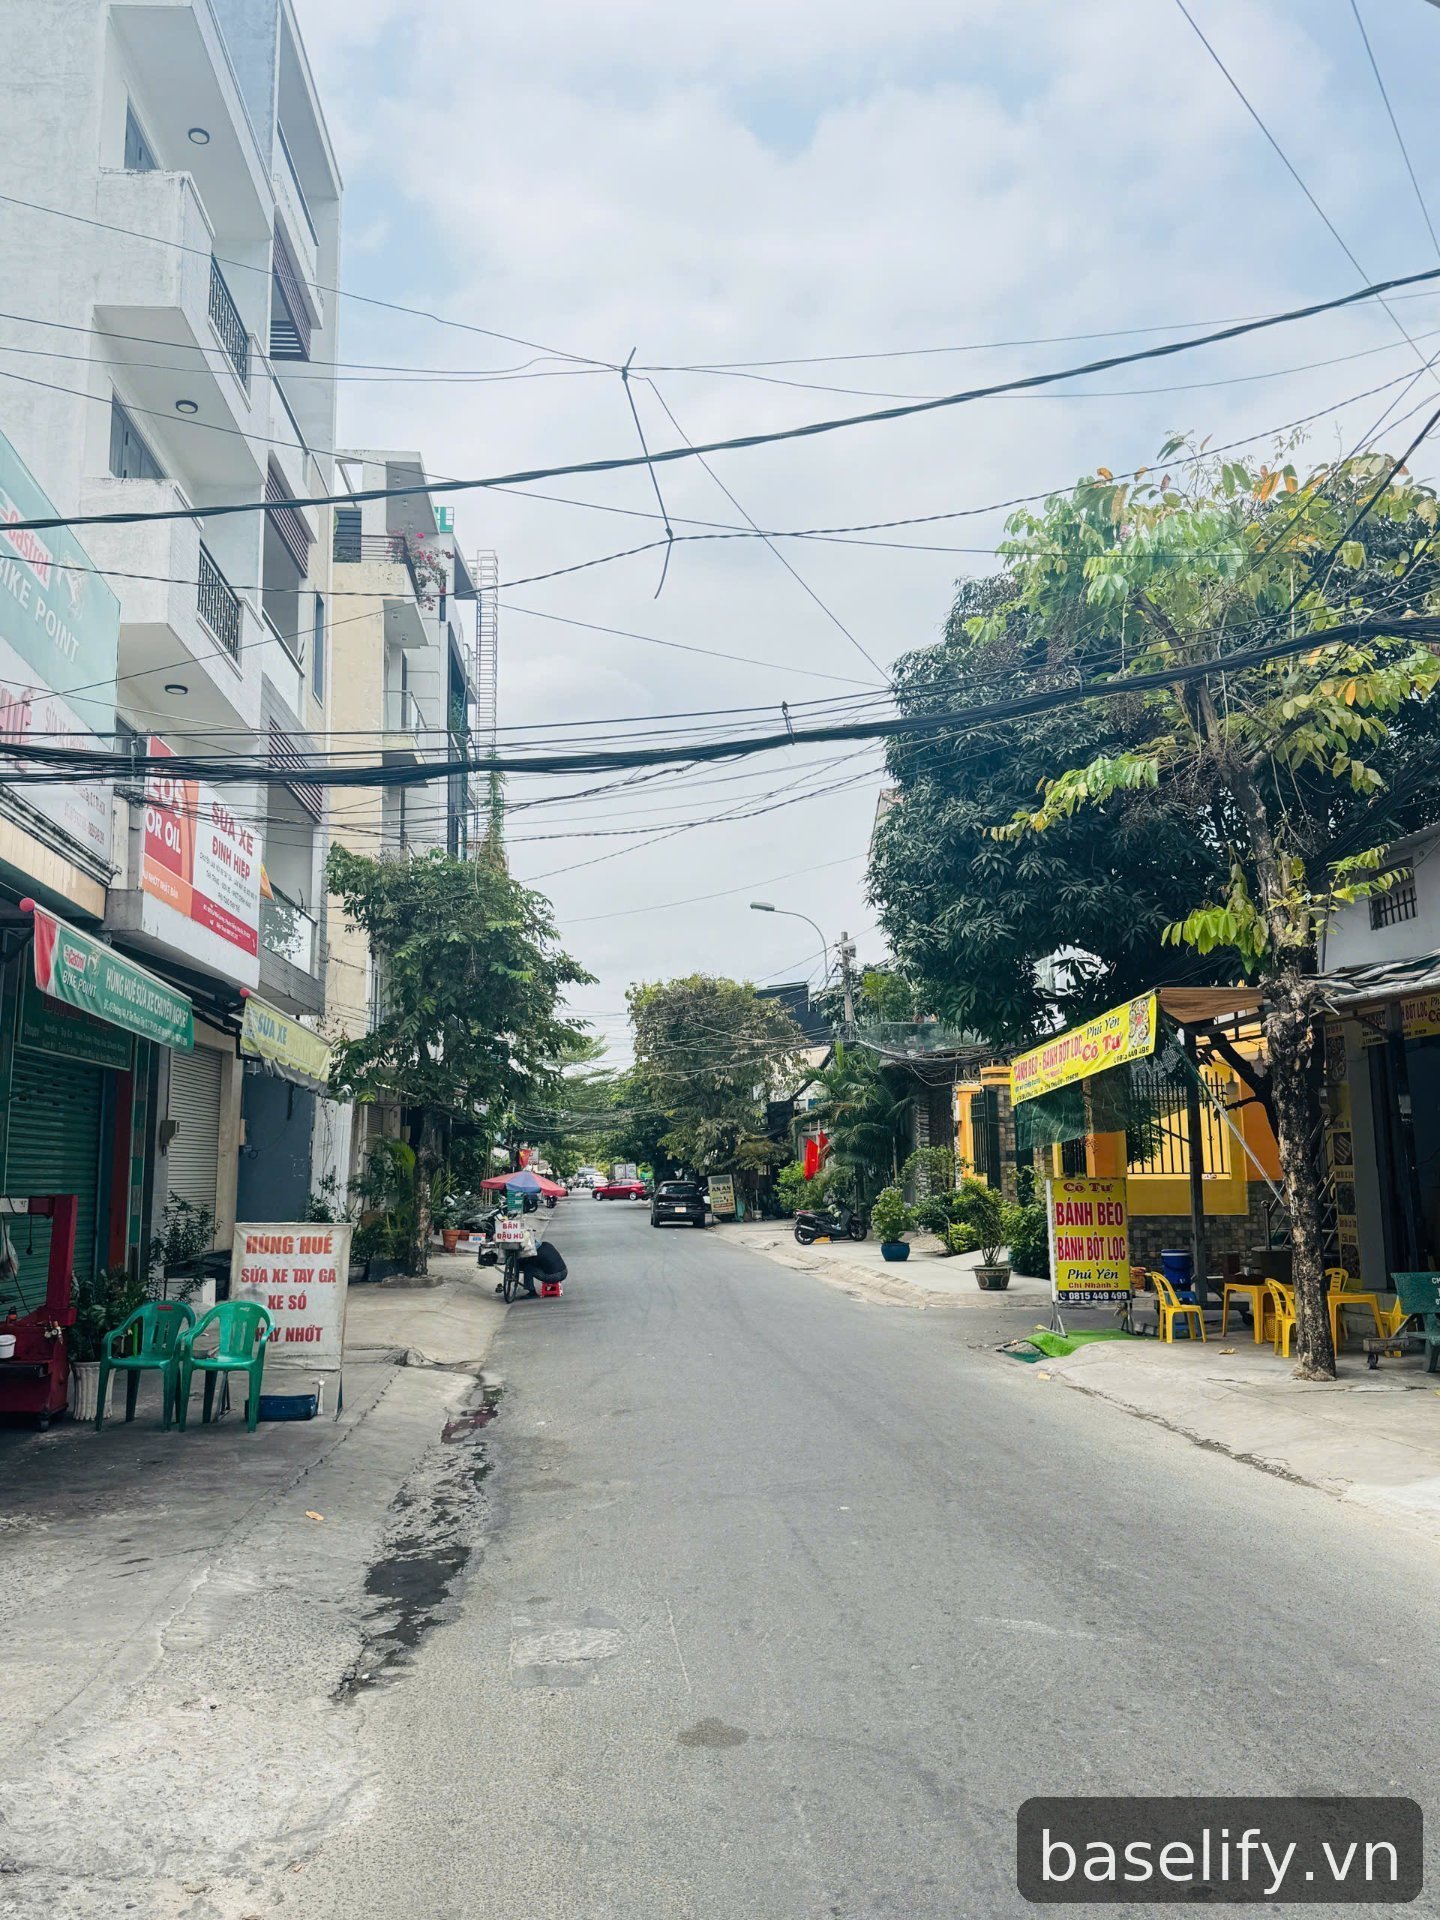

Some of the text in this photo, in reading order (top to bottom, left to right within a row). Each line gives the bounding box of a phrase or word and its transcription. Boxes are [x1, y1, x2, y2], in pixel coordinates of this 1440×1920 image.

[0, 558, 31, 610] IKE
[35, 596, 79, 663] POINT
[165, 821, 181, 855] OIL
[62, 970, 97, 998] BIKE POINT
[1105, 1016, 1120, 1030] Yên
[1081, 1033, 1123, 1062] Cô Tư
[1063, 1182, 1114, 1193] Cô Tư
[1056, 1197, 1124, 1226] BÁNH BÈO
[246, 1230, 334, 1255] HÙNG HUẾ
[1057, 1231, 1126, 1266] BÁNH BỘT LỌC
[241, 1265, 336, 1283] SỬA XE TAY GA
[1067, 1268, 1119, 1280] Phú Yên
[268, 1290, 307, 1310] XE SỐ
[1068, 1291, 1127, 1300] 0815 449 499
[285, 1325, 323, 1342] NHỚT
